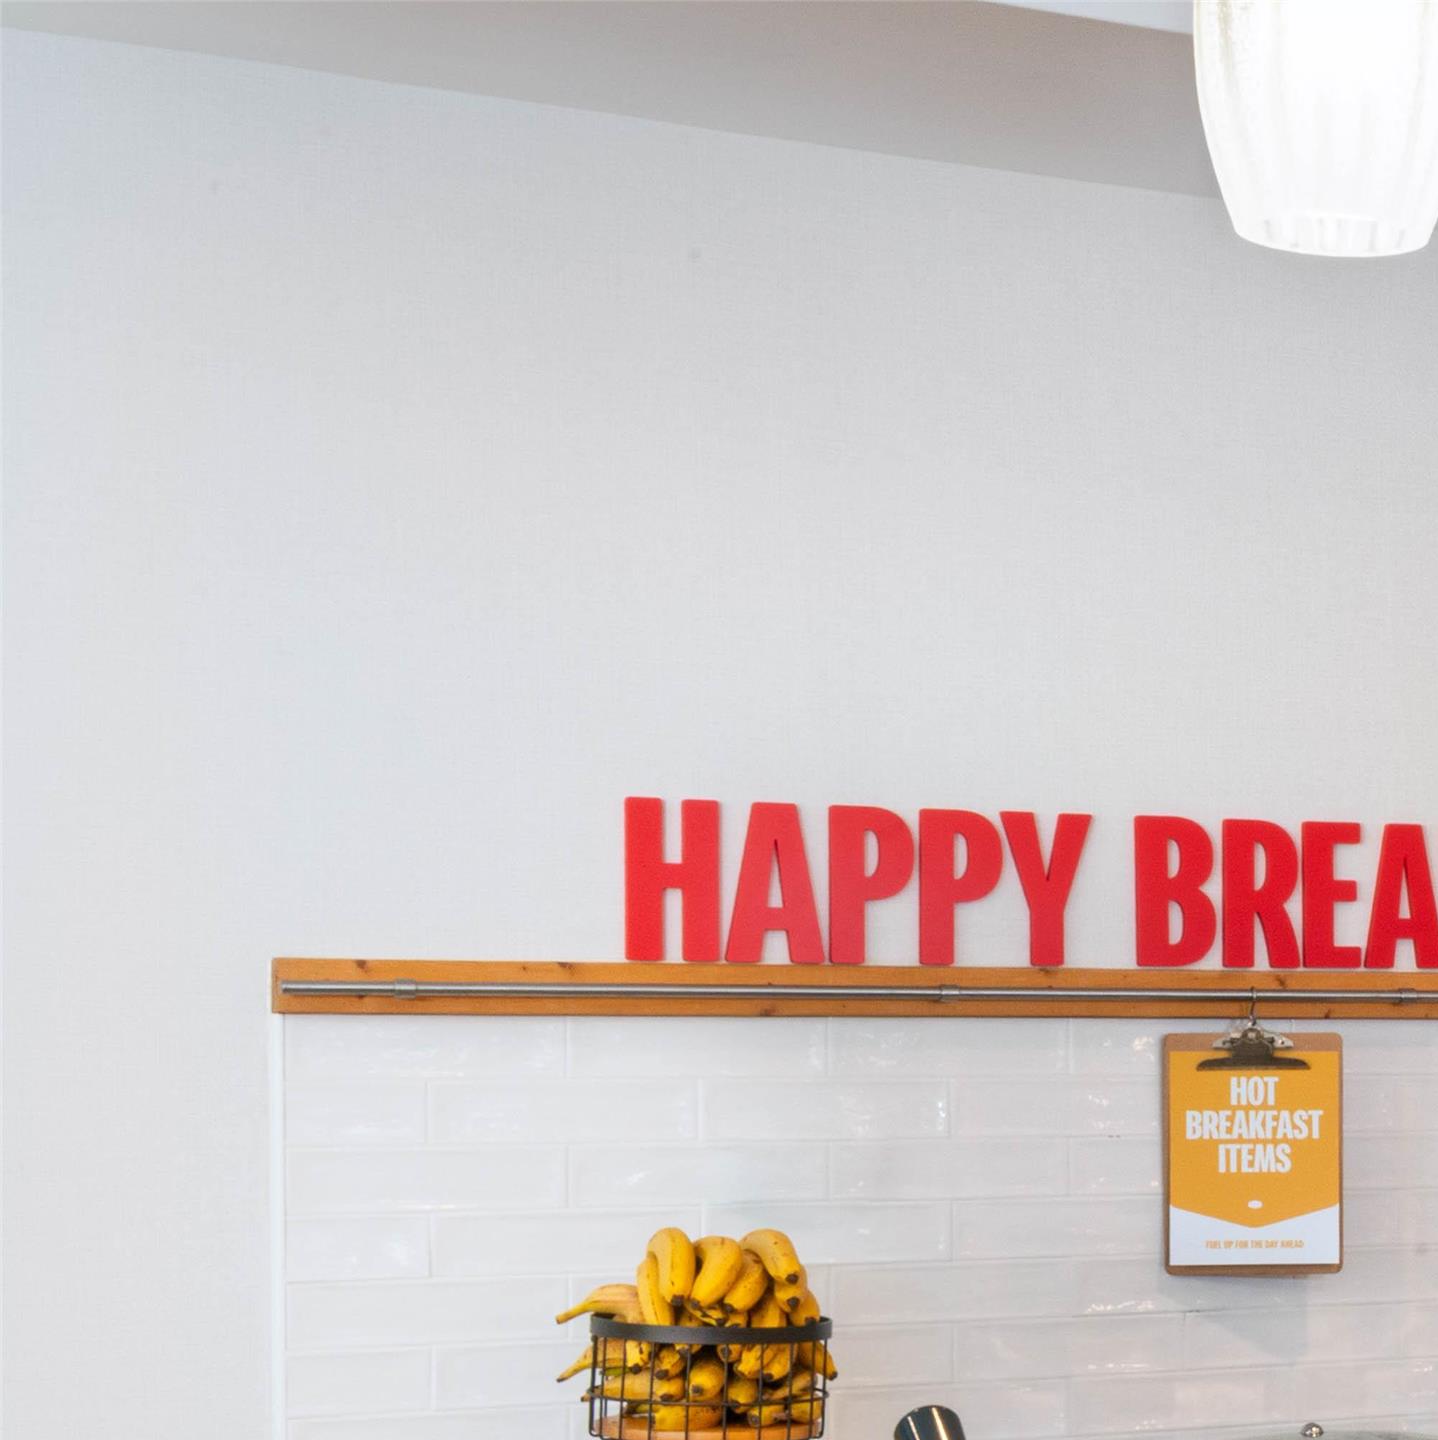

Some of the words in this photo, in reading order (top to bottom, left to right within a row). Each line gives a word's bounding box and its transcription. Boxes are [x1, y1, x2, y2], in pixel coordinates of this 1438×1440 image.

[625, 797, 1092, 966] HAPPY
[1230, 1076, 1279, 1106] HOT
[1185, 1109, 1323, 1140] BREAKFAST
[1218, 1143, 1292, 1173] ITEMS
